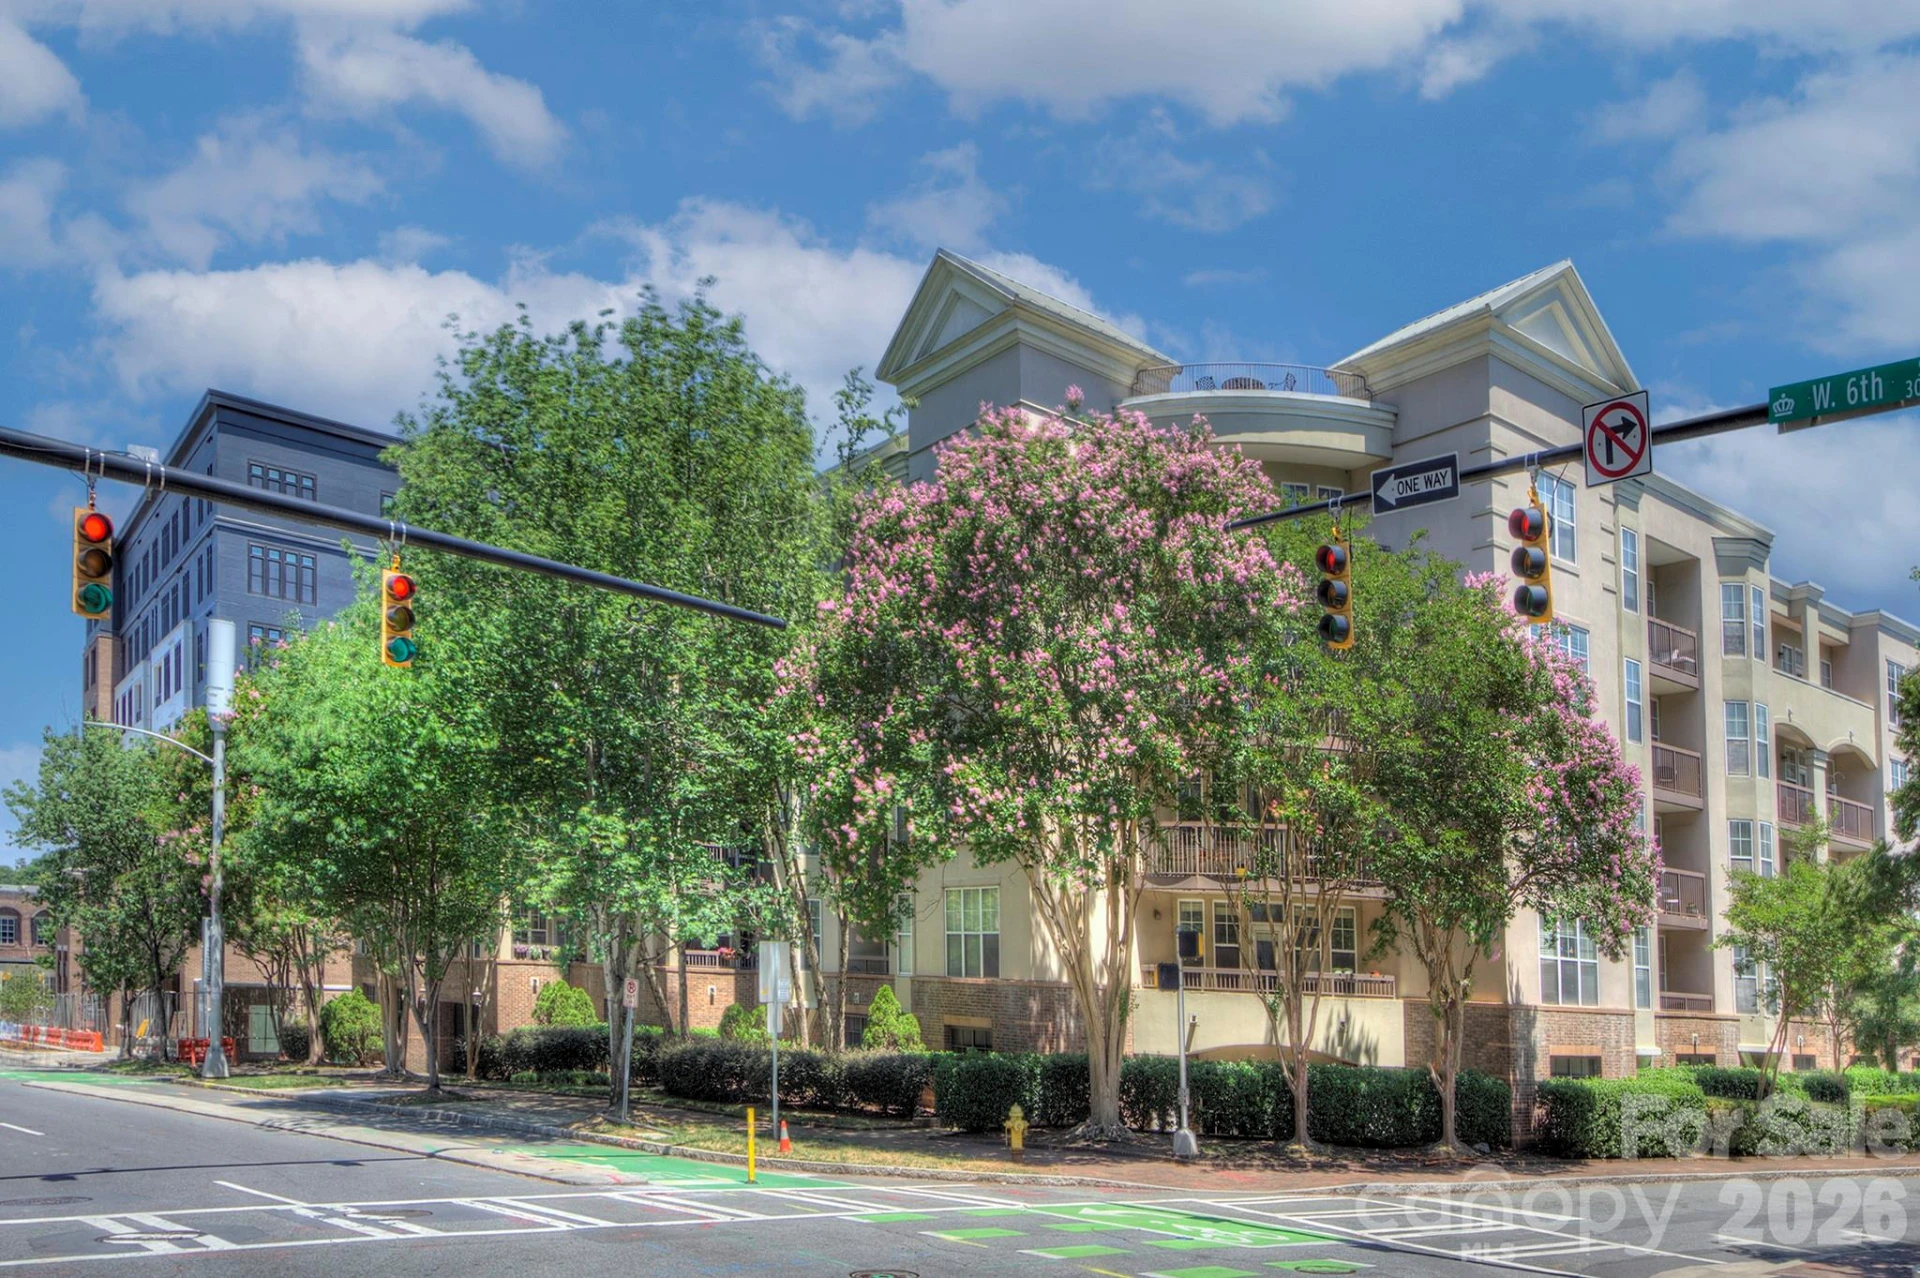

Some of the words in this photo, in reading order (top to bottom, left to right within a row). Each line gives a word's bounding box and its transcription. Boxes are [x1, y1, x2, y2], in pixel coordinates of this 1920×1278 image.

[1812, 381, 1836, 411] W.
[1846, 371, 1884, 406] 6th
[1397, 477, 1420, 496] ONE
[1423, 470, 1448, 490] WAY
